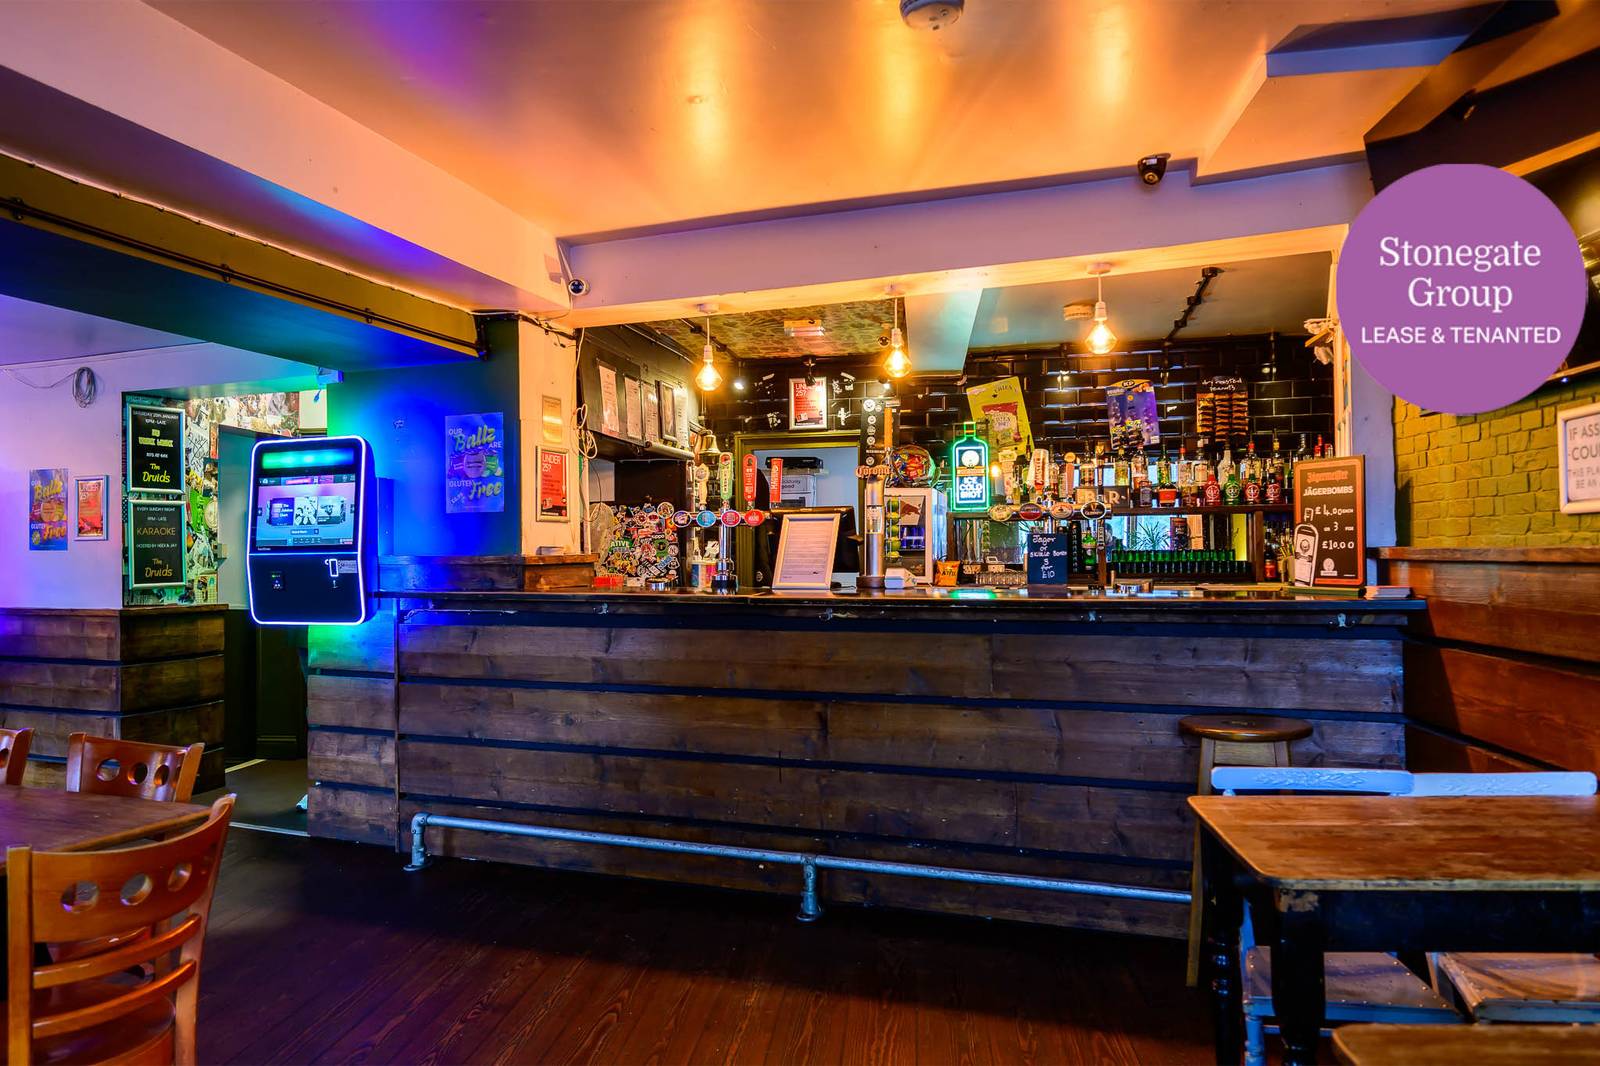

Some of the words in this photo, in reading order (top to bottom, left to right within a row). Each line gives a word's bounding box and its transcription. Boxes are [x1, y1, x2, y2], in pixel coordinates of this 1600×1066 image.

[448, 428, 463, 436] OUR
[1569, 427, 1578, 441] IF
[488, 441, 503, 449] ARE
[541, 454, 562, 464] UNDER
[142, 470, 170, 483] Druids
[856, 465, 890, 478] Corona
[960, 483, 982, 491] COLD
[1088, 489, 1121, 504] BR
[1333, 521, 1339, 531] 3
[136, 528, 176, 536] KARAOKE
[145, 564, 173, 577] Druids
